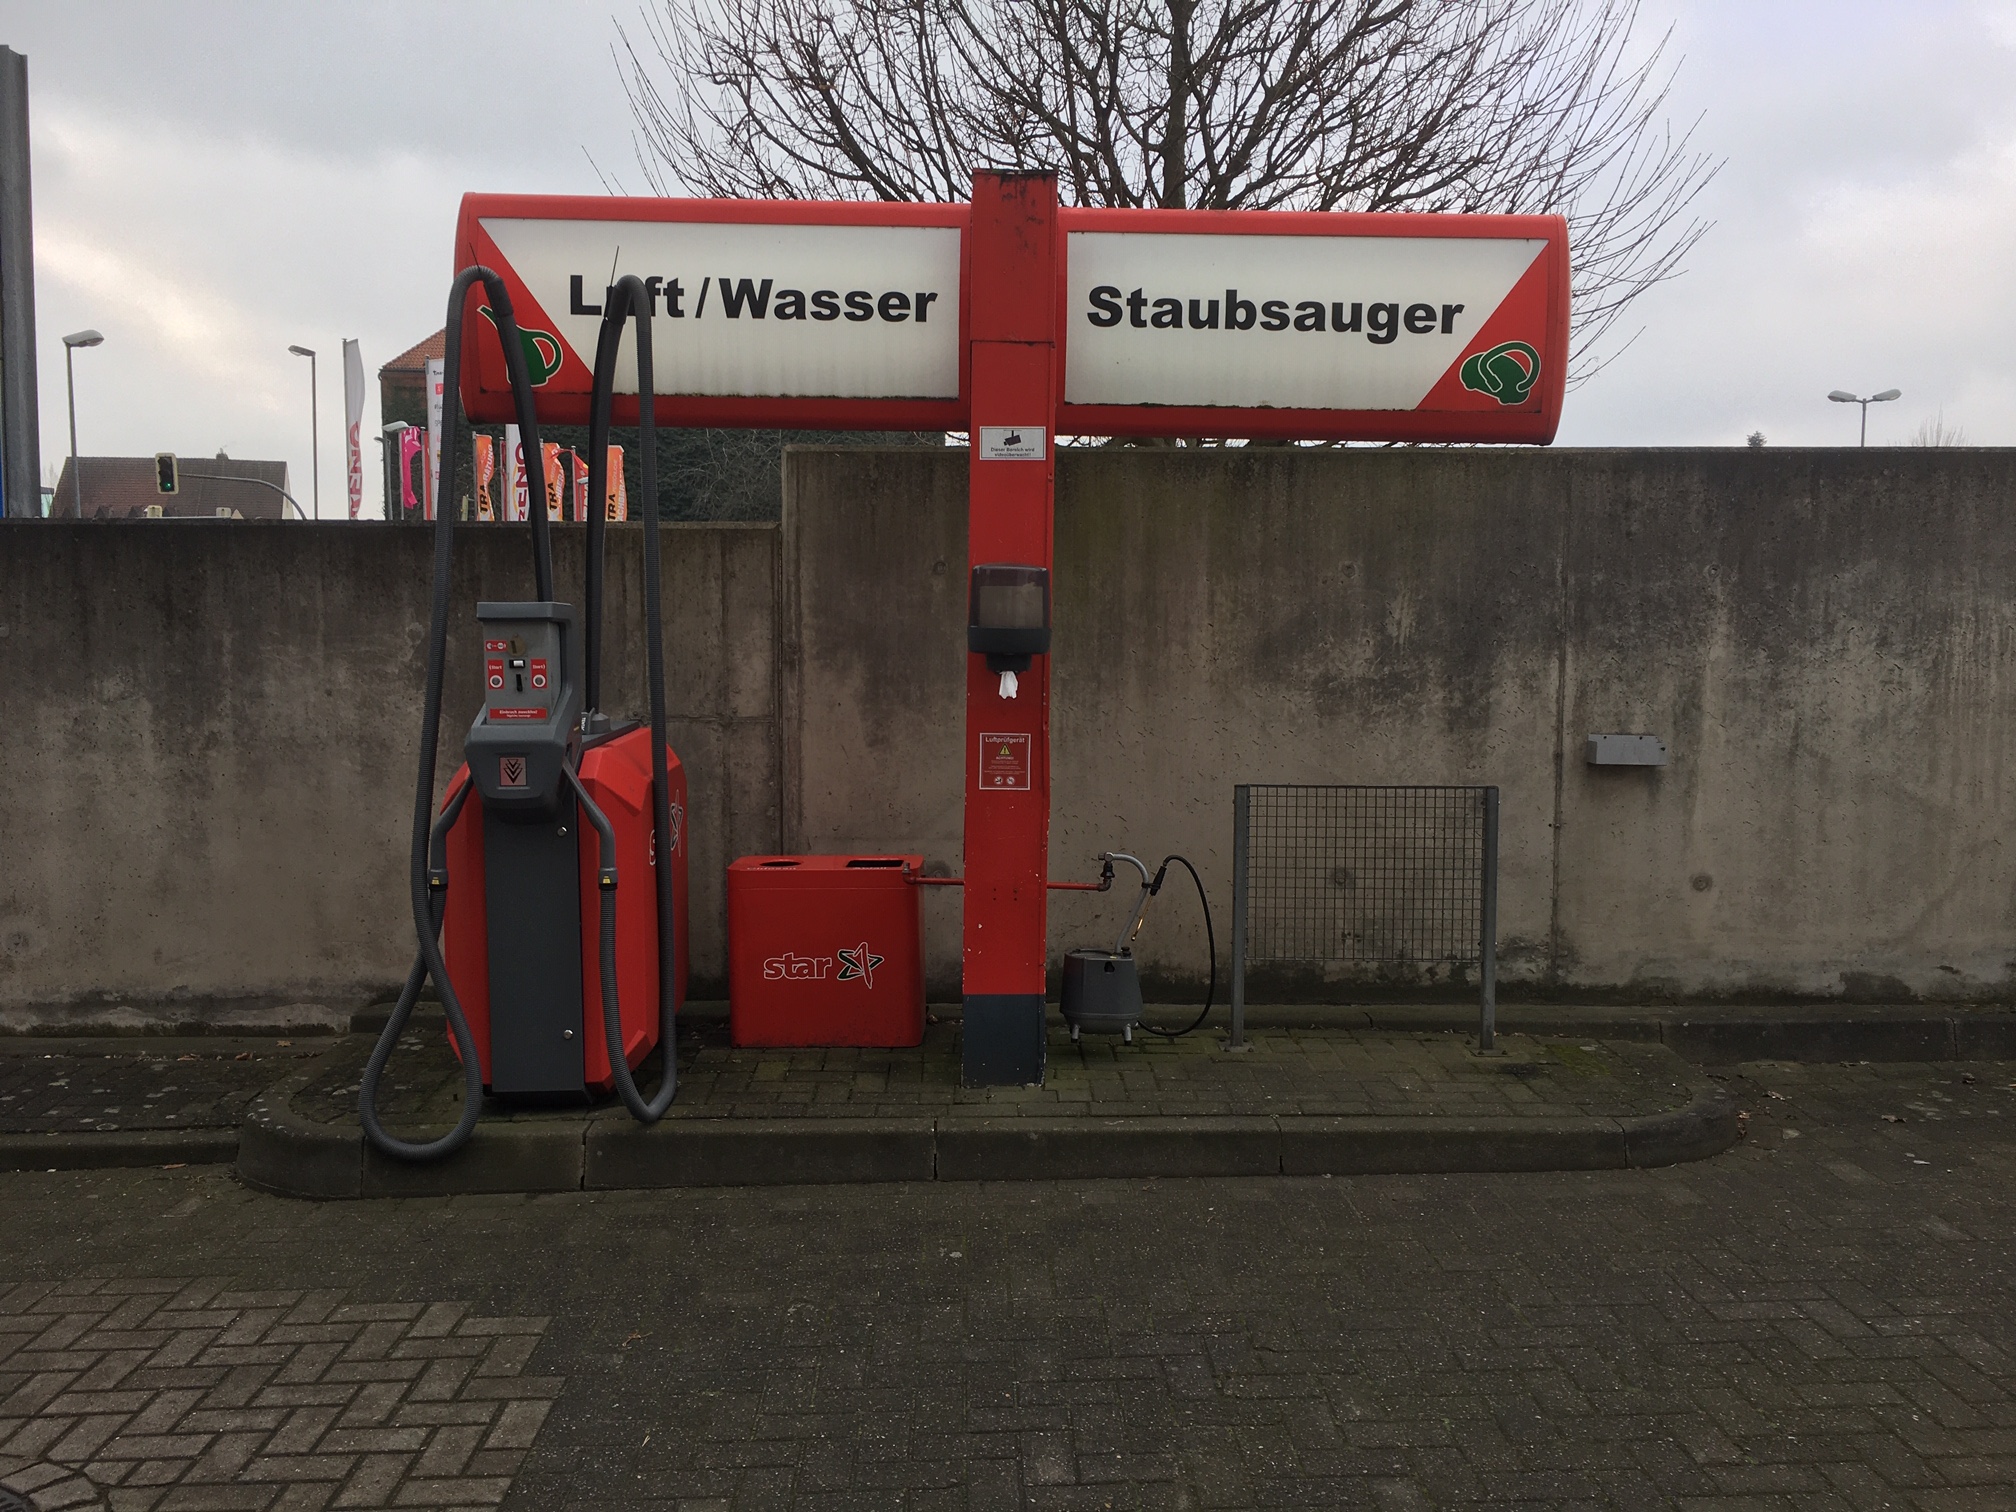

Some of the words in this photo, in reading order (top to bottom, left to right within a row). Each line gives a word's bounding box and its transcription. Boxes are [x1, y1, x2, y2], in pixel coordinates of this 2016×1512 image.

[569, 274, 938, 323] Lft/Wasser
[1086, 284, 1465, 345] Staubsauger
[763, 951, 833, 980] star
